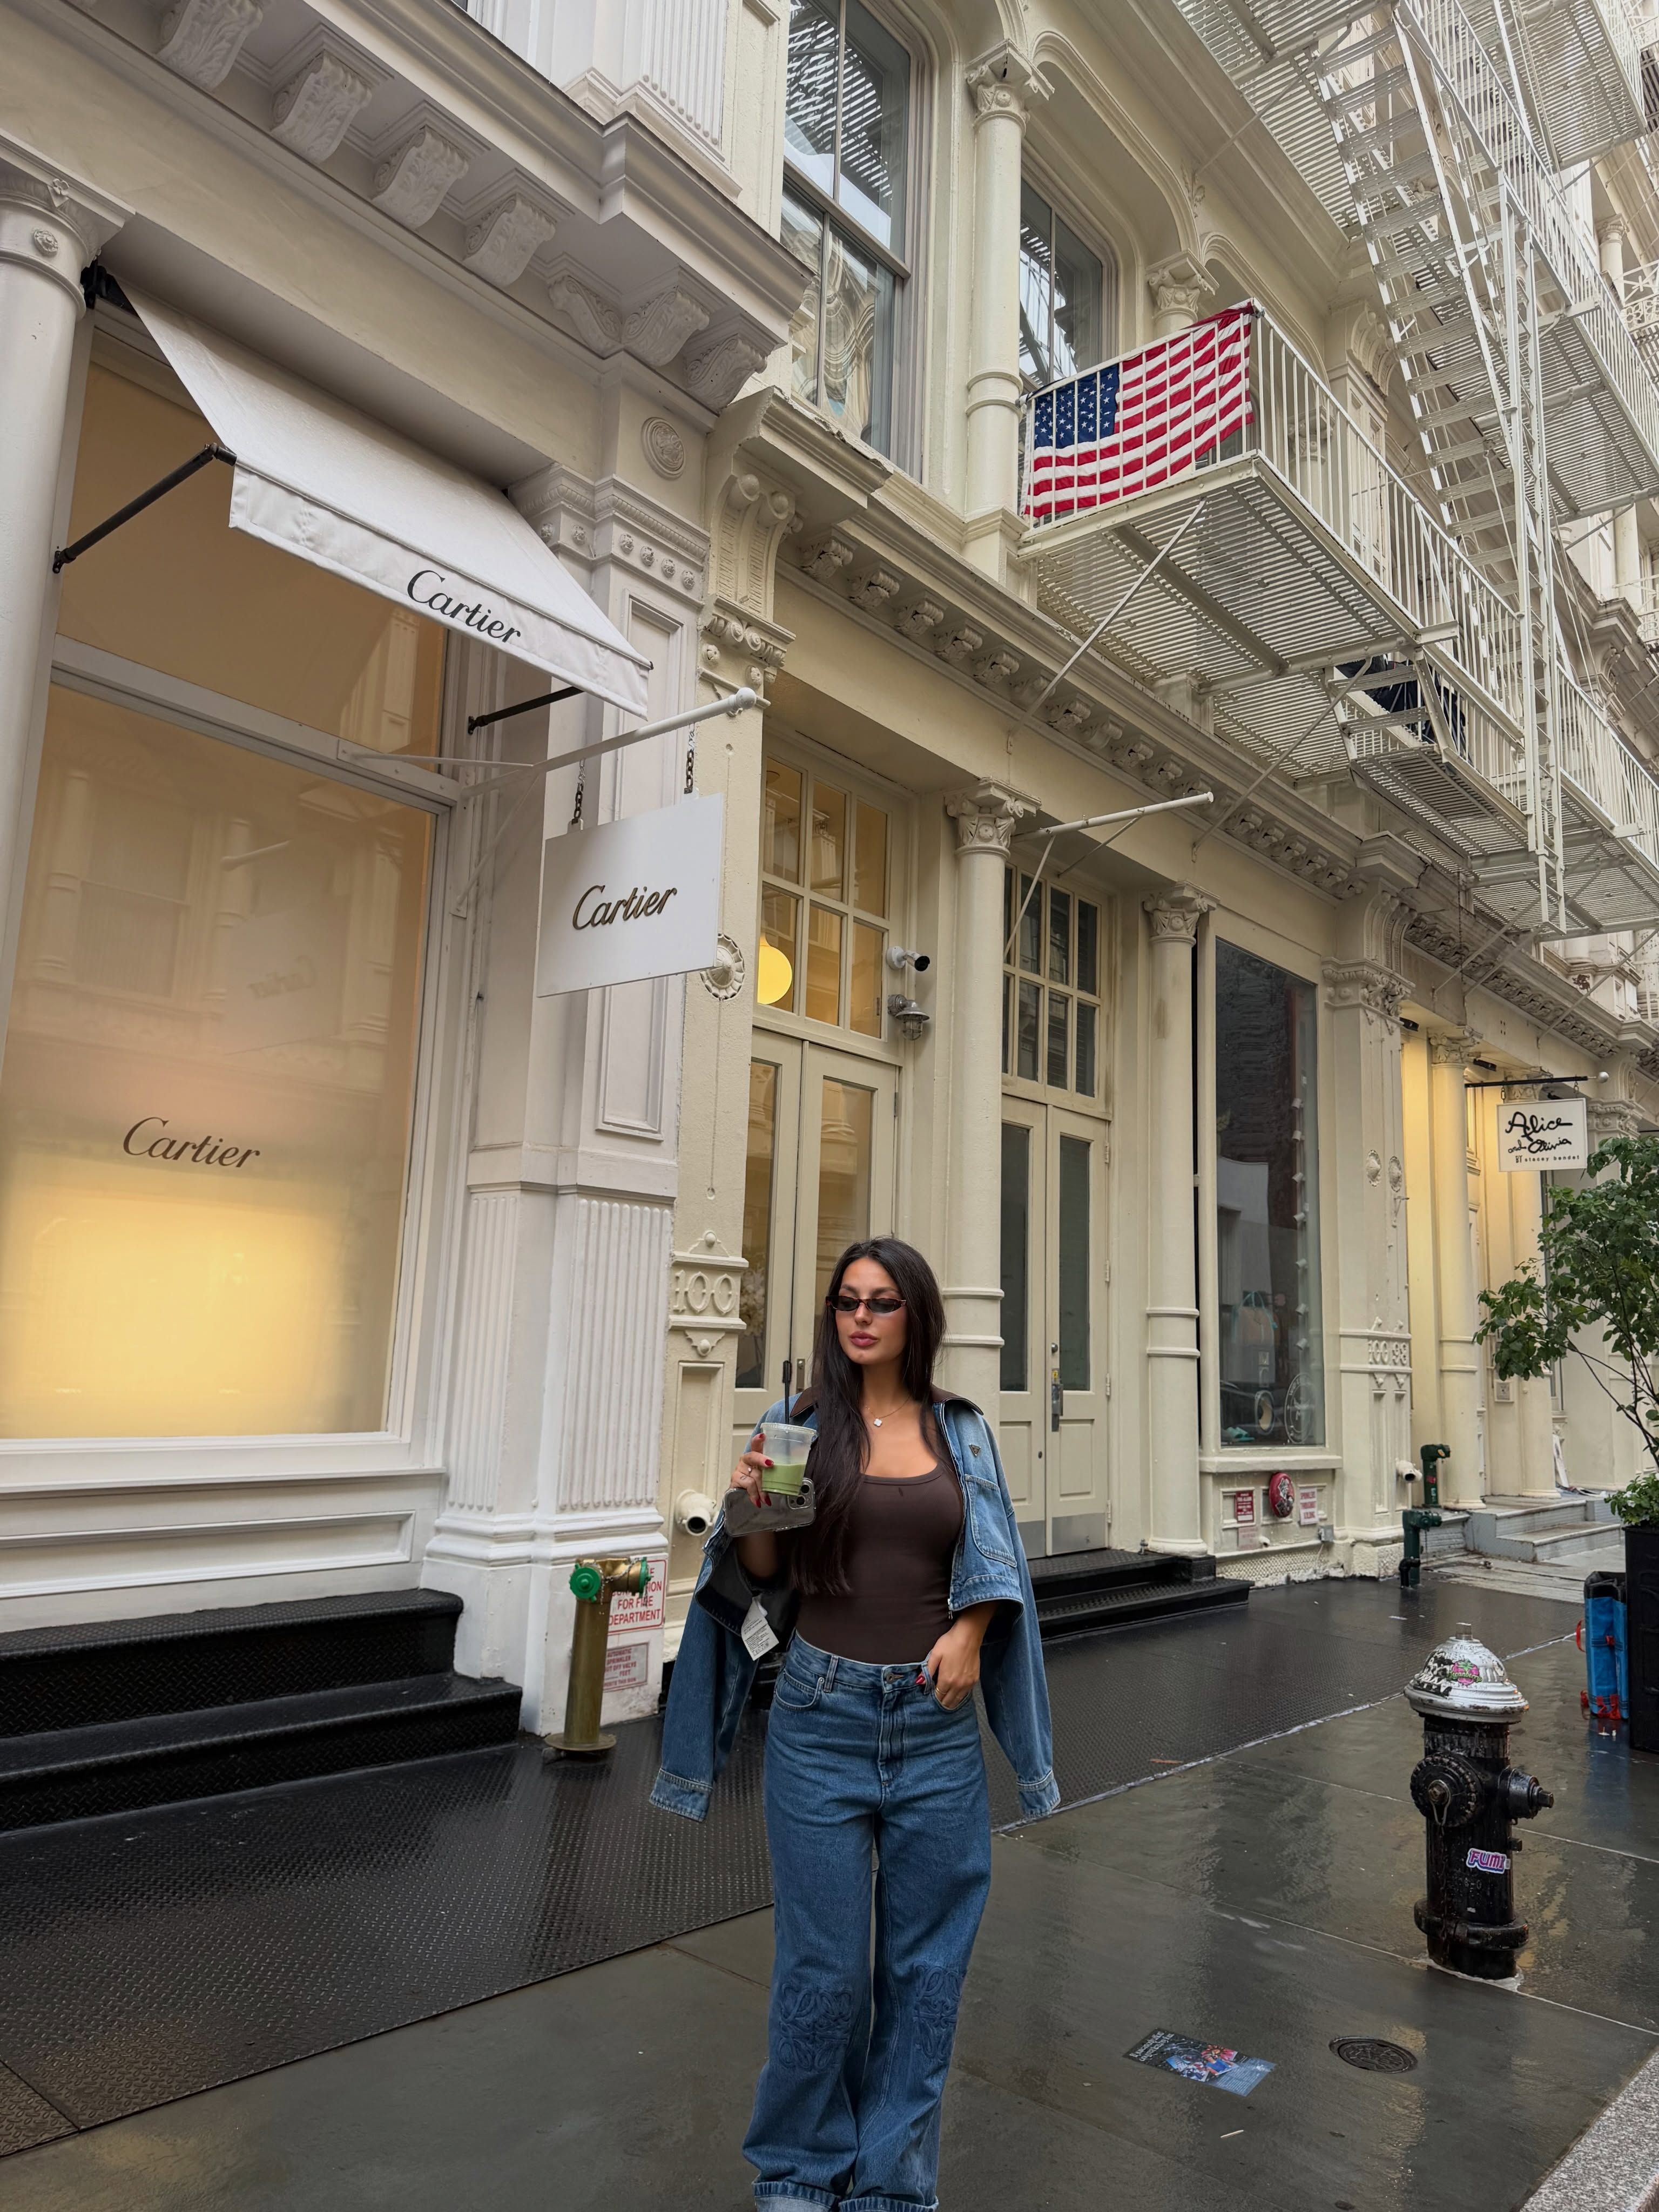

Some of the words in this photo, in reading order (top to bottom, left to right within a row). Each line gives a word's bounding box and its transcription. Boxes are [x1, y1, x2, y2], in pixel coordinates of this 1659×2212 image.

[407, 570, 521, 643] Cartier
[572, 885, 678, 930] Cartier
[1505, 1111, 1573, 1137] Alice
[123, 1117, 261, 1168] Cartier
[1527, 1137, 1572, 1154] Olivia
[673, 1270, 737, 1314] 100
[609, 1609, 661, 1626] DEPARTMENT
[617, 1597, 634, 1610] FOR
